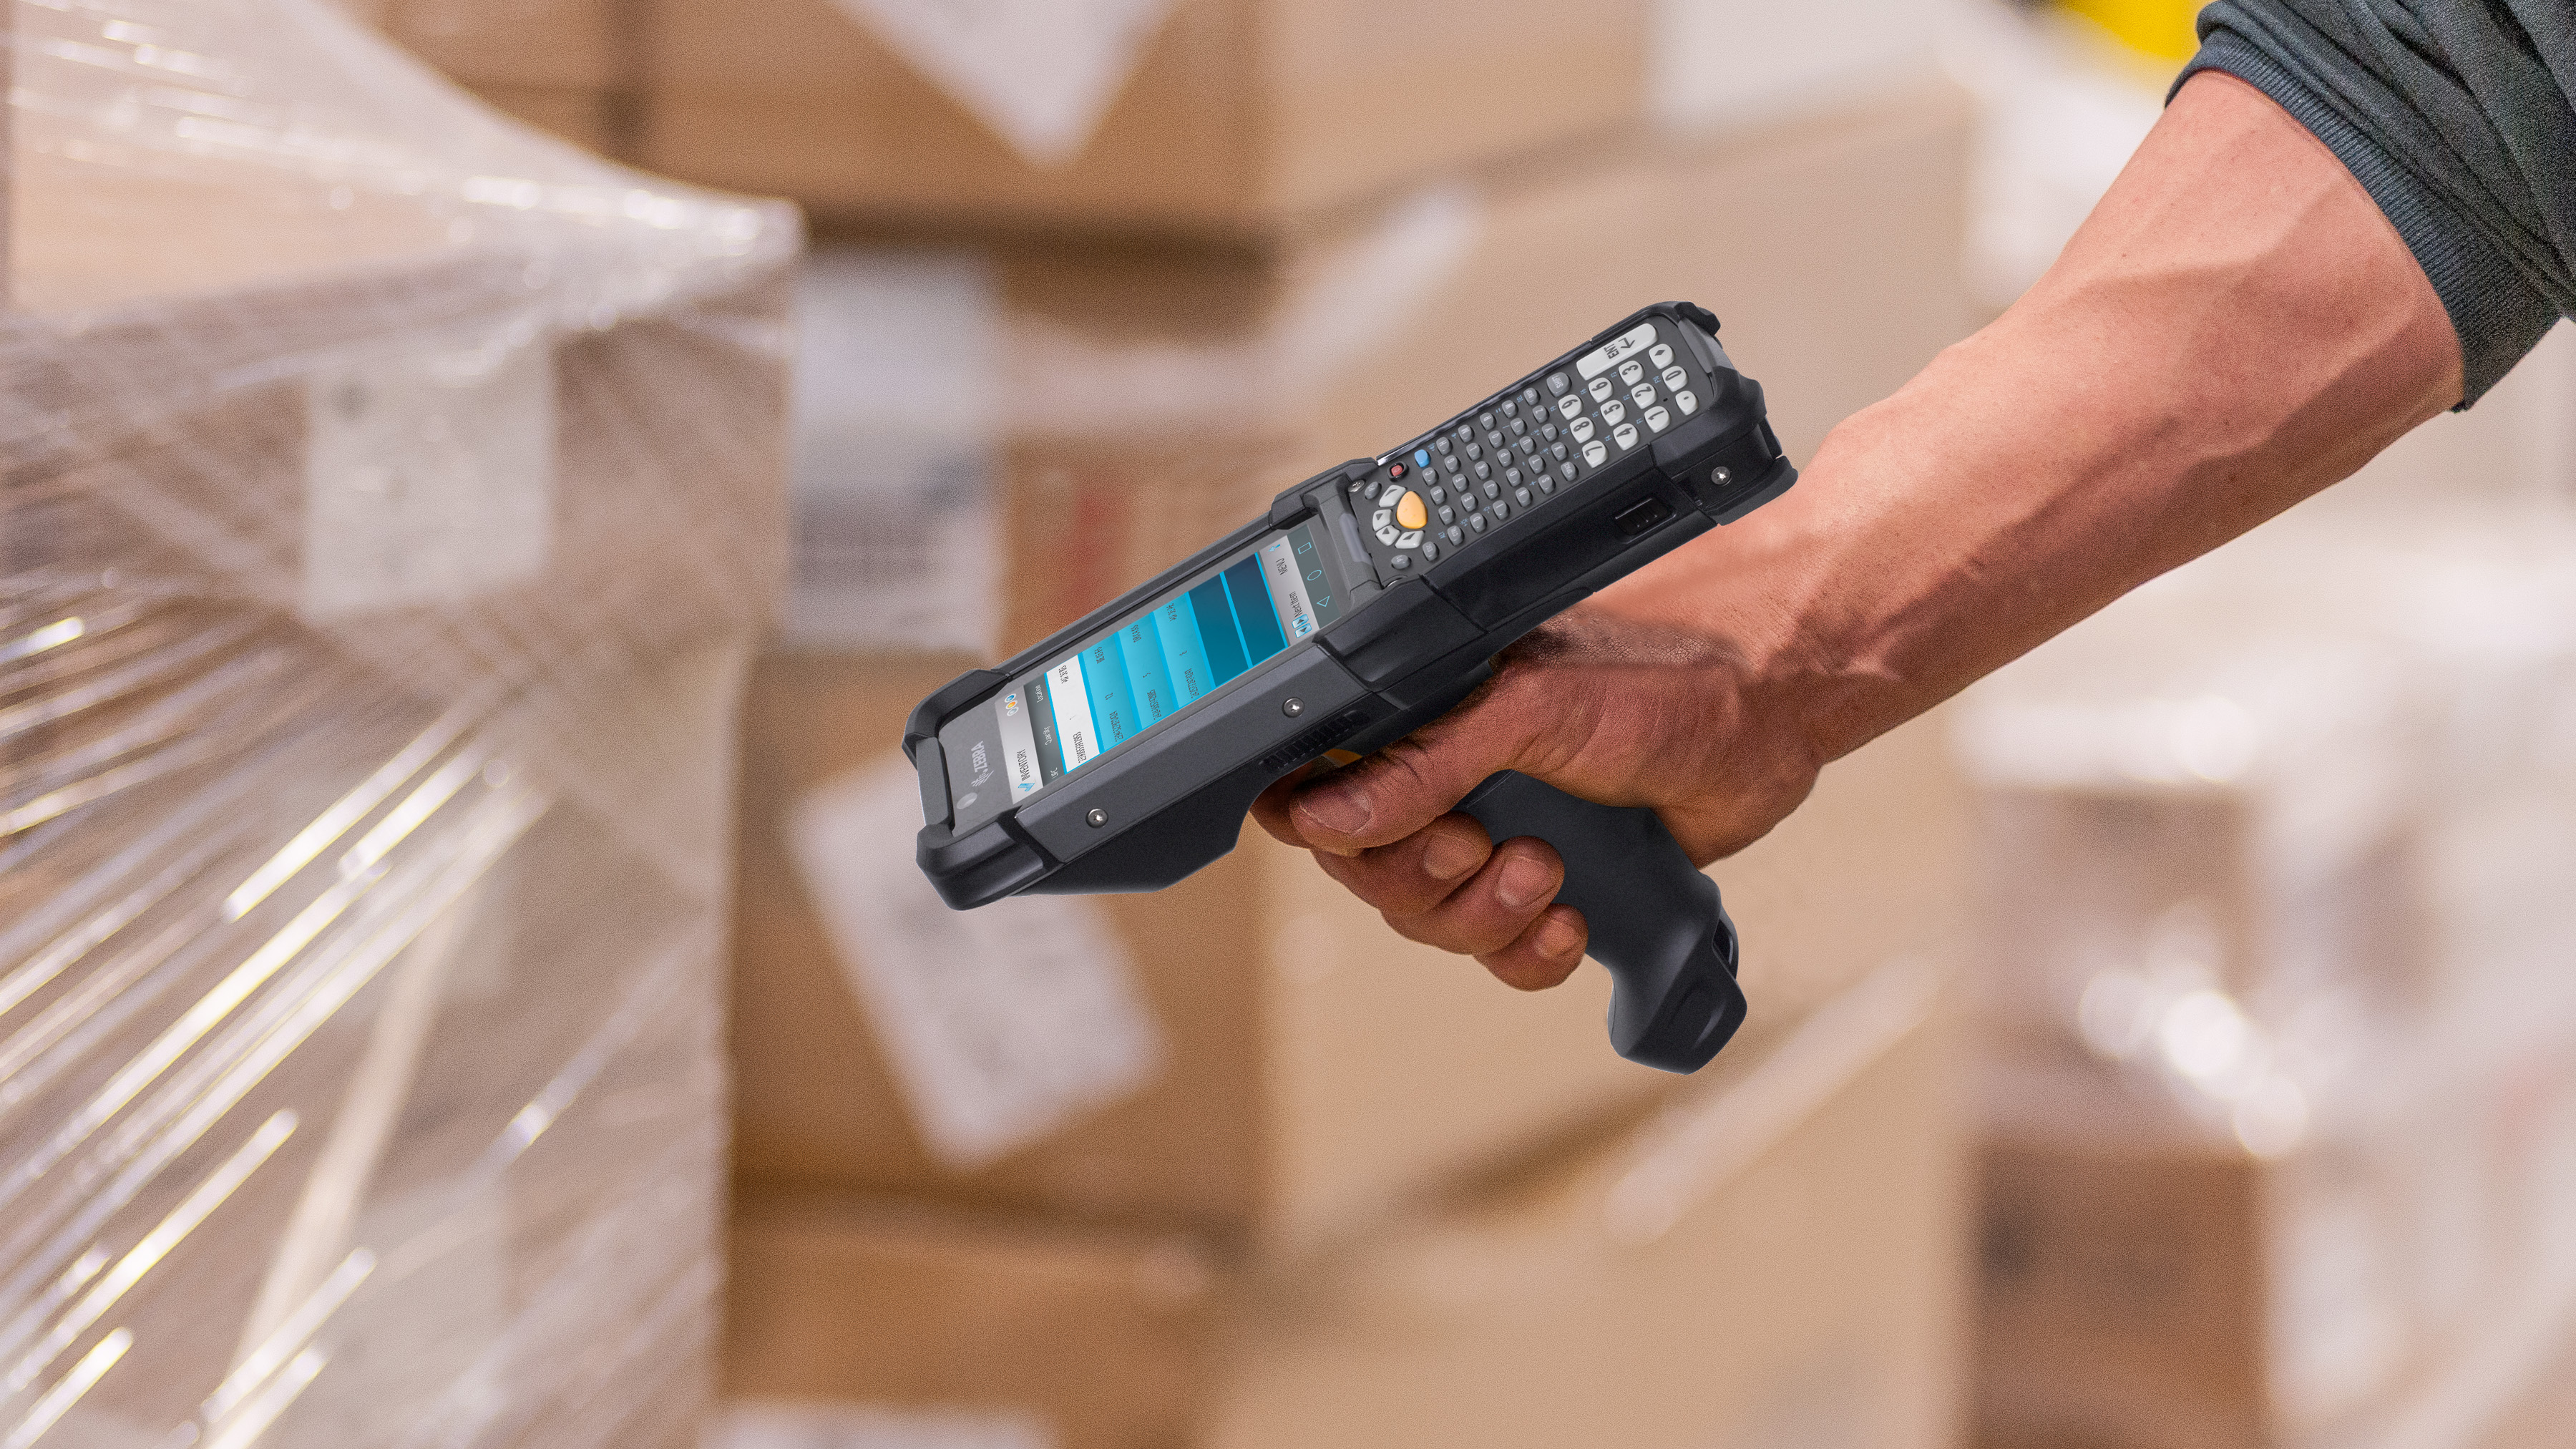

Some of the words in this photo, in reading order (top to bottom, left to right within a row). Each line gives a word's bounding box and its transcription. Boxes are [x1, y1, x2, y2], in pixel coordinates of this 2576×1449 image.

[1604, 343, 1619, 359] ENT
[1622, 365, 1639, 376] 3
[1551, 376, 1563, 389] SHIFT
[1591, 381, 1608, 391] 6
[1634, 386, 1652, 398] 2
[1562, 399, 1578, 409] 9
[1604, 404, 1621, 415] 5
[1648, 411, 1664, 420] 1
[1574, 421, 1590, 431] 8
[1616, 427, 1632, 437] 4
[1585, 446, 1602, 457] 7
[1563, 462, 1573, 474] SPACE
[1275, 558, 1287, 575] MENU
[1289, 591, 1299, 605] Item
[1292, 602, 1303, 618] Next
[1043, 726, 1052, 745] Quantity
[971, 741, 988, 773] ZEBRA
[1017, 749, 1030, 781] INVENTORY
